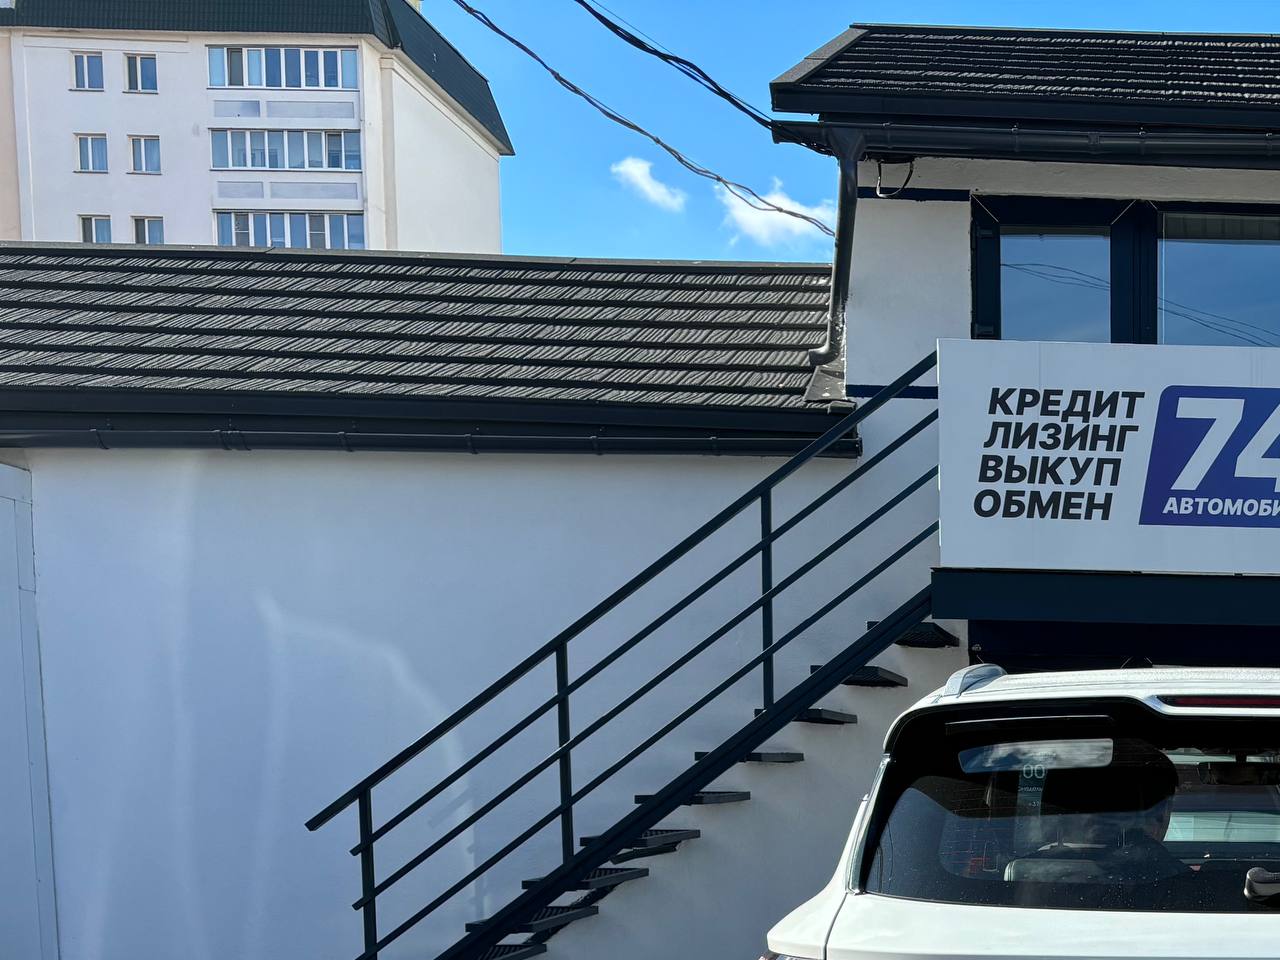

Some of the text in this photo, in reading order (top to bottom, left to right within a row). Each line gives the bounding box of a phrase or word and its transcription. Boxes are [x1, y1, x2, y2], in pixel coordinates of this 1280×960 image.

[987, 387, 1145, 423] КРЕДИТ
[983, 422, 1139, 453] ЛИЗИНГ
[978, 455, 1122, 487] ВЫКУП
[973, 489, 1113, 521] ОБМЕН
